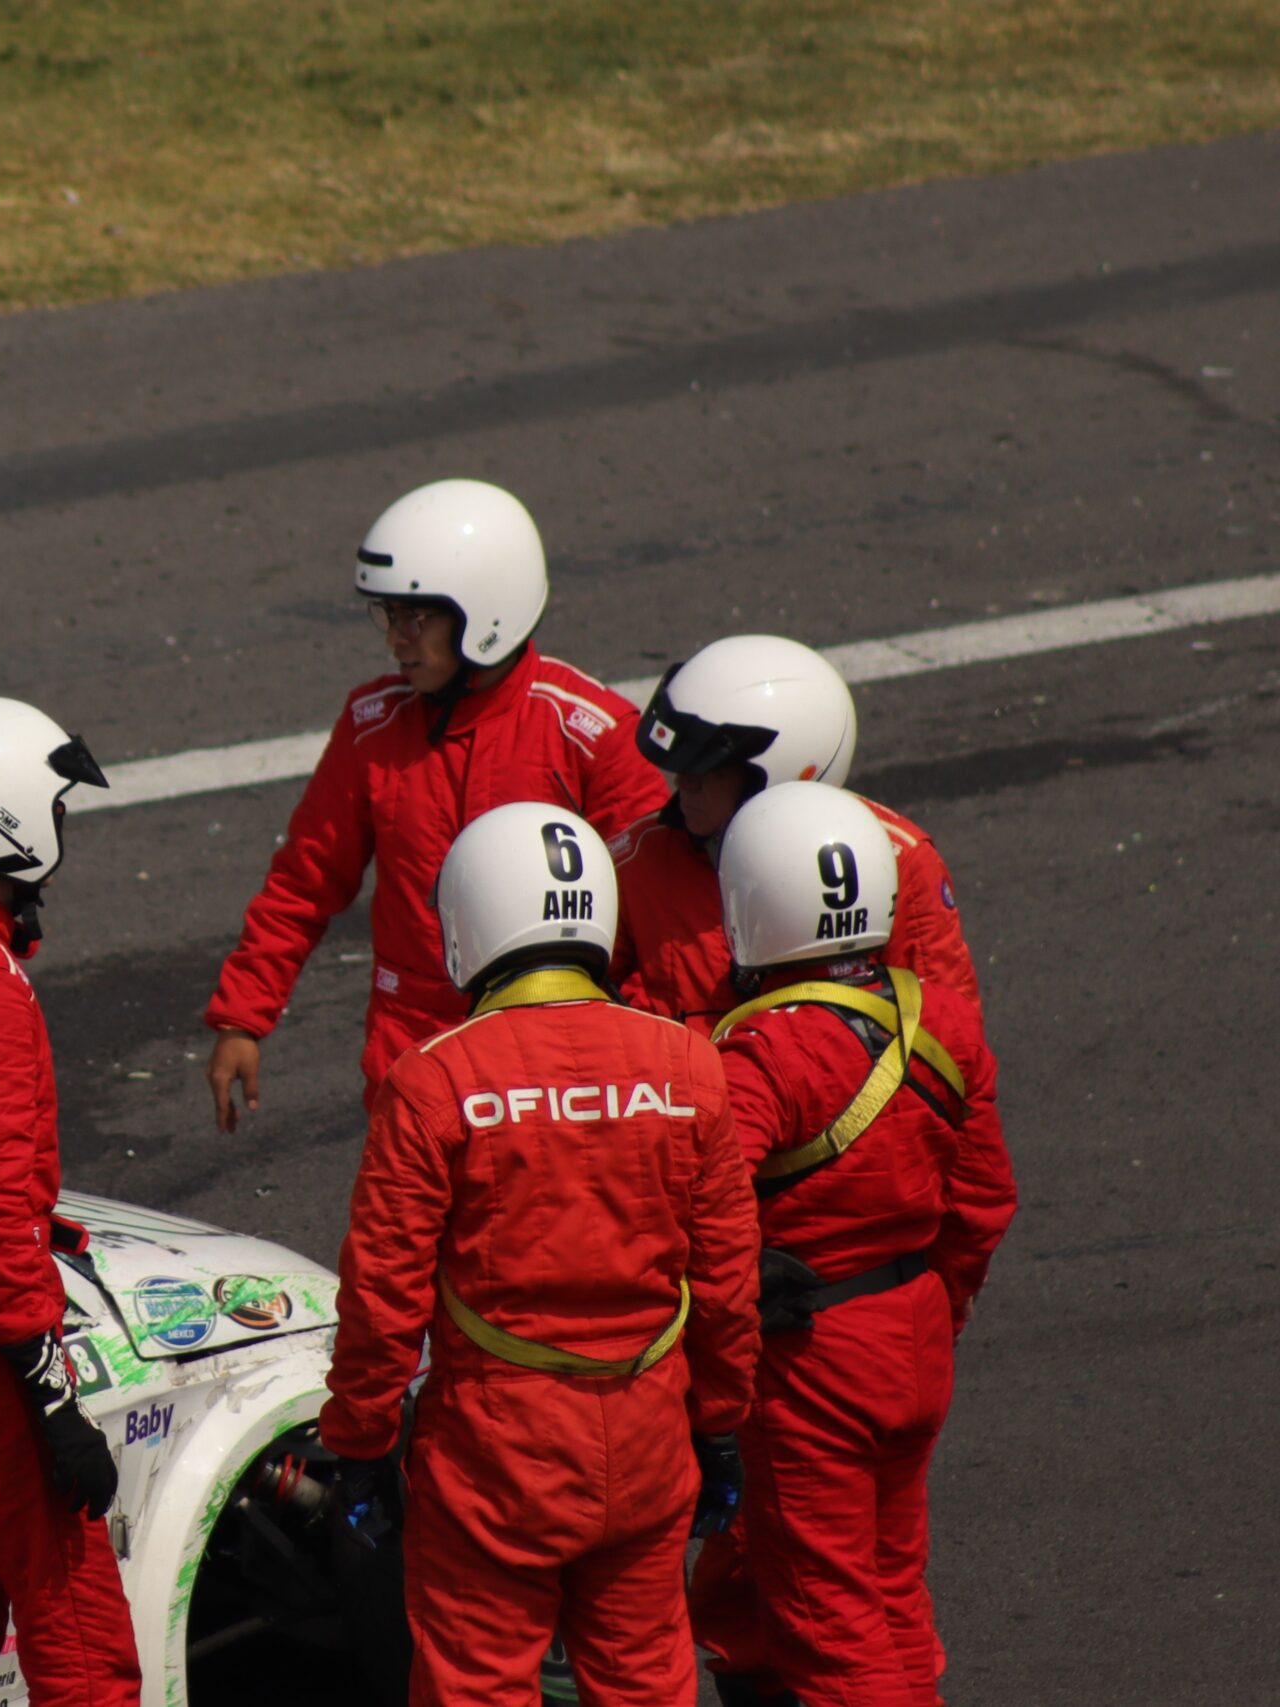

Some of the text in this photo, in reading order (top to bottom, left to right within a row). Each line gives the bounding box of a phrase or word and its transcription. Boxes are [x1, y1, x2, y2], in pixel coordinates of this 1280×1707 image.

[570, 710, 603, 736] OMP
[541, 822, 583, 882] 6
[817, 843, 859, 910] 9
[543, 890, 593, 920] AHR
[816, 908, 868, 940] AHR
[464, 1083, 695, 1127] OFICIAL
[46, 1347, 65, 1389] OMP
[125, 1403, 174, 1445] Baby
